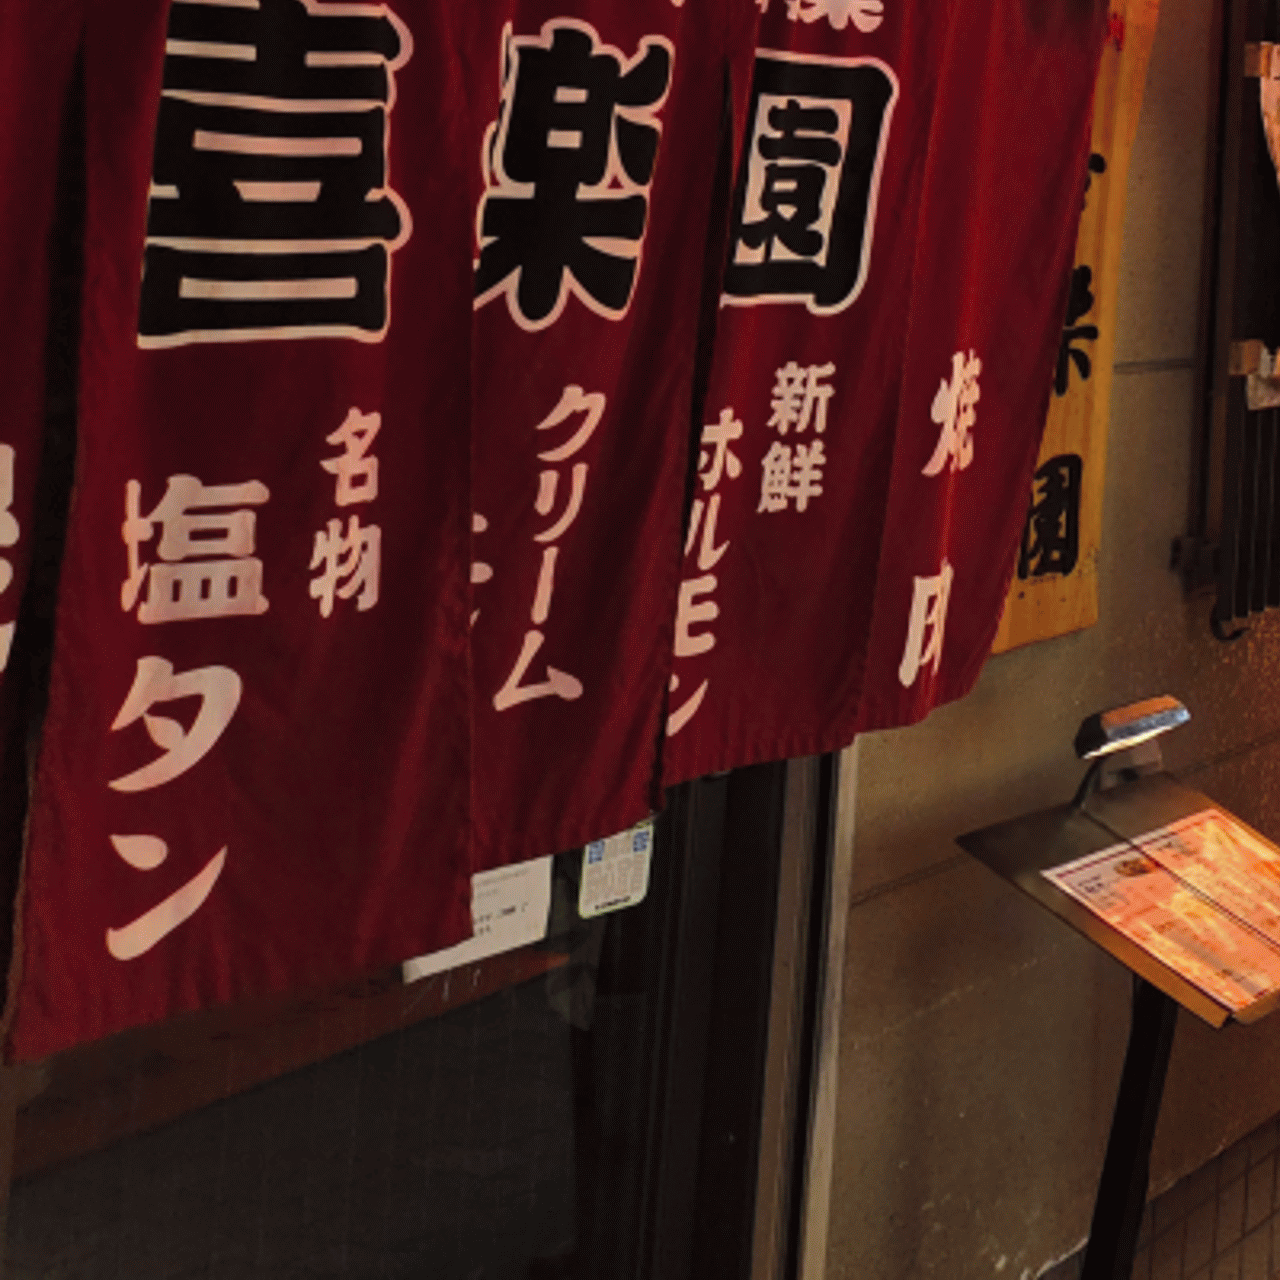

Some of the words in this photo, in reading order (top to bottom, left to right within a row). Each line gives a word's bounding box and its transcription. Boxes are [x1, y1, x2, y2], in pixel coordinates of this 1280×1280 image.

[309, 406, 382, 619] 名物
[493, 384, 606, 712] クリーム
[756, 361, 836, 514] 新鮮
[105, 474, 270, 961] 塩タン
